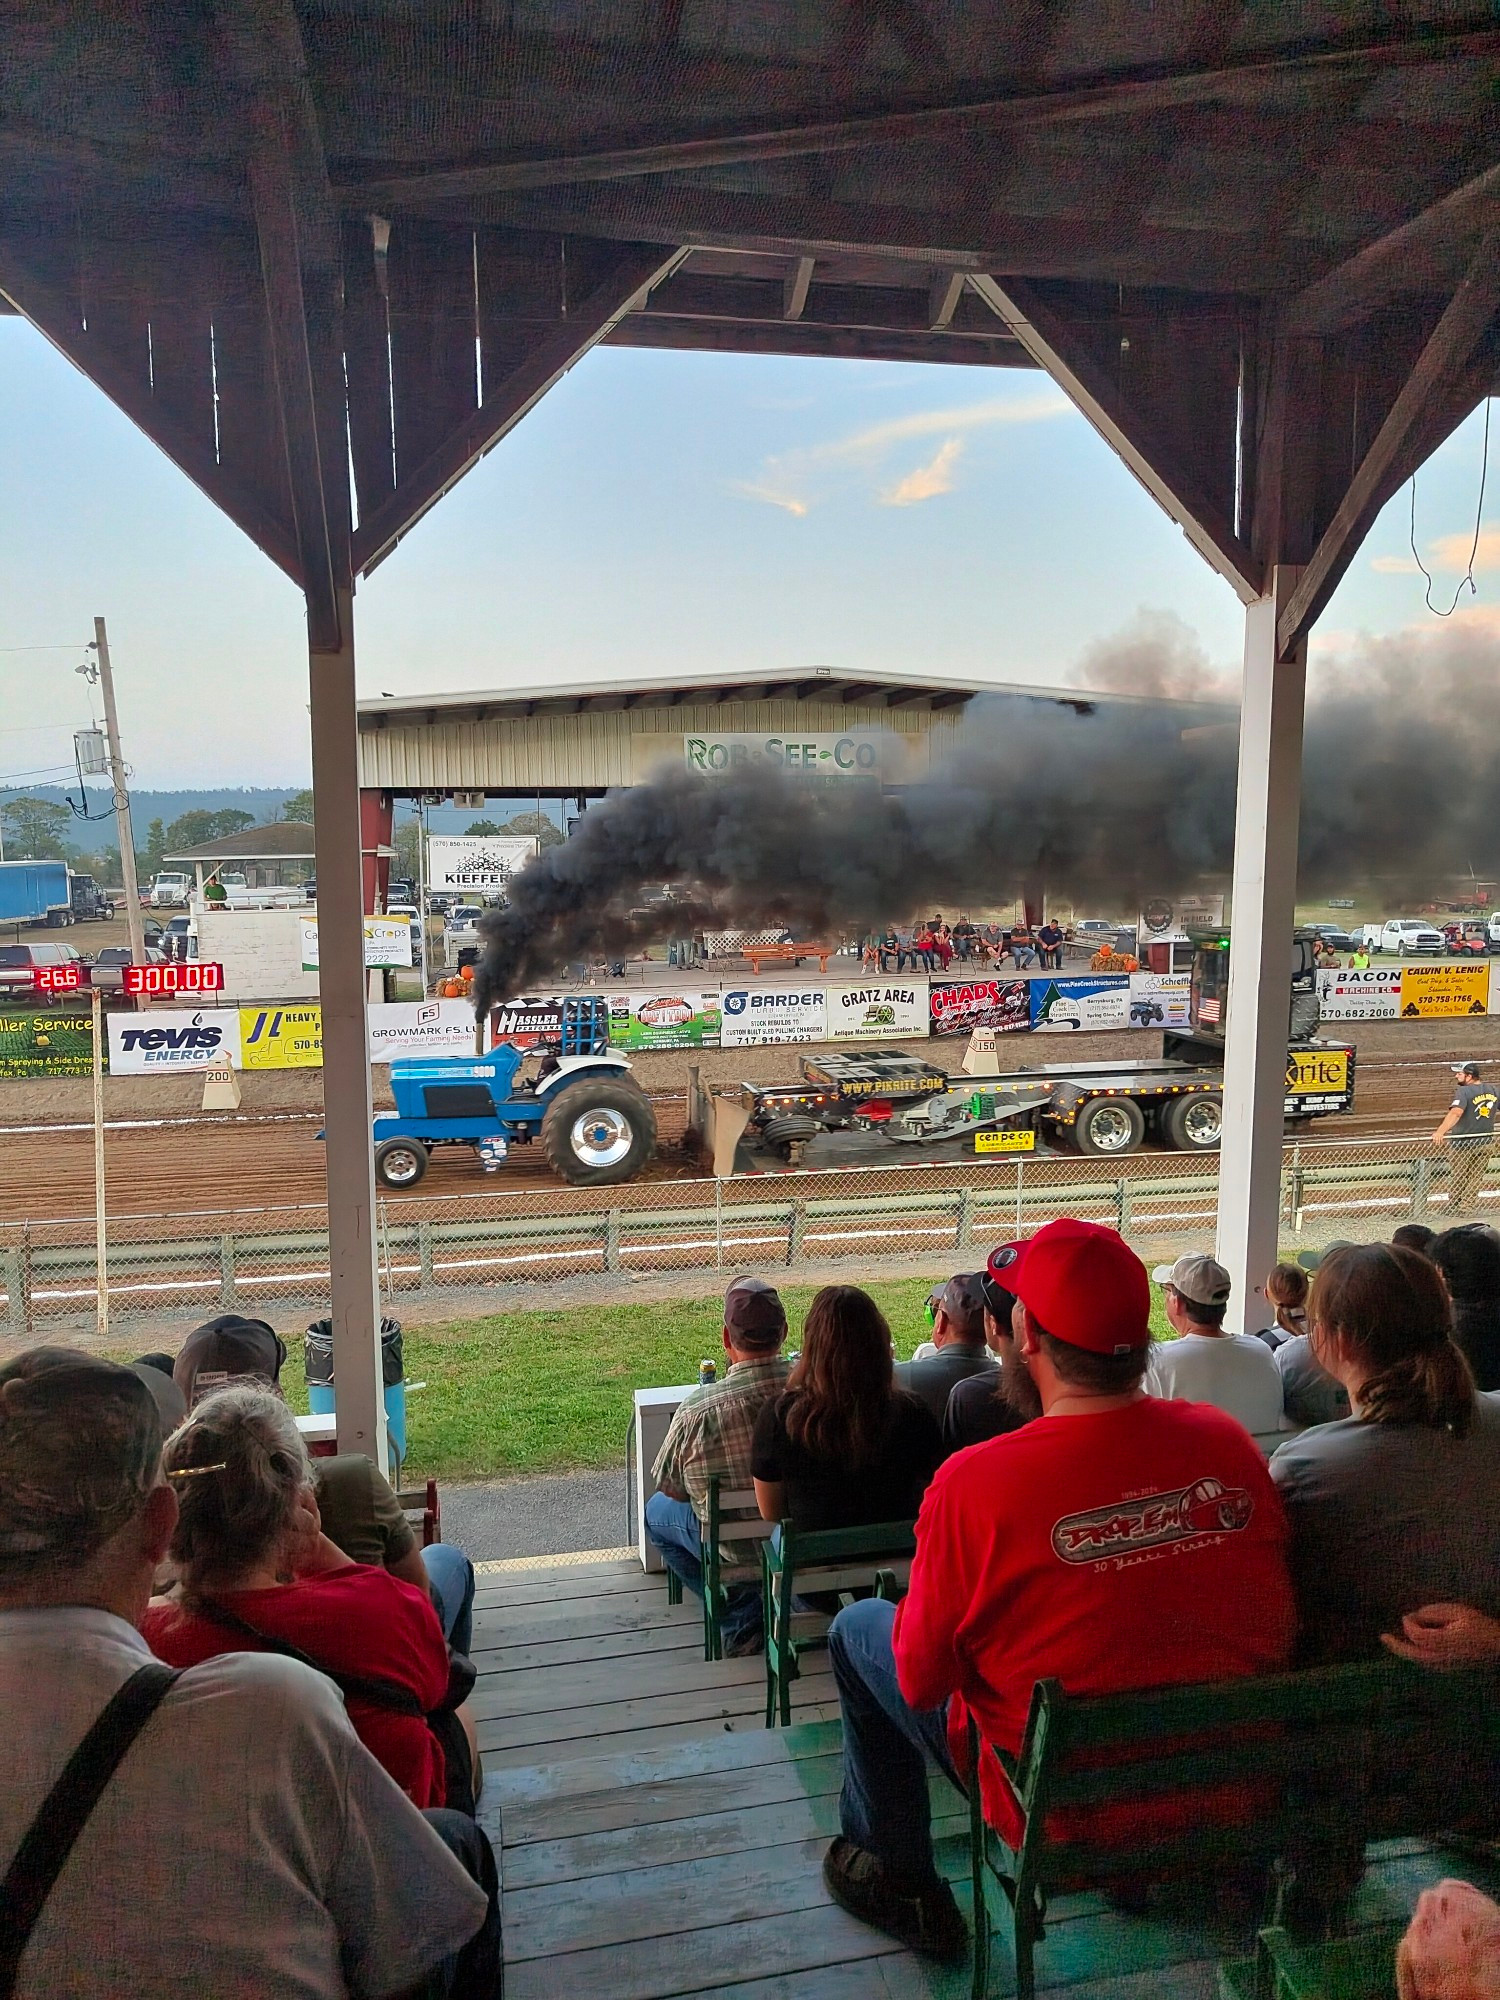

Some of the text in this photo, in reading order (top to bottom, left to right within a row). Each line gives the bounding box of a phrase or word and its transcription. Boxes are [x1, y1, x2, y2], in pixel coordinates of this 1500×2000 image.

[1408, 966, 1485, 976] CALVIN V. LENIG
[128, 965, 218, 992] 300.00
[1337, 972, 1402, 982] BACON
[1381, 986, 1395, 994] CO.
[750, 993, 824, 1007] BARDER
[841, 988, 915, 1008] GRATZ AREA
[931, 980, 1001, 1018] CHADS
[1418, 994, 1473, 1004] 570-758-1766
[285, 1012, 316, 1023] HEAVY
[422, 1008, 436, 1020] FS
[1320, 1008, 1396, 1018] 570-682-2060
[497, 1010, 559, 1034] HASSLER
[372, 1027, 441, 1038] GROWMARK
[833, 1029, 854, 1037] Antique
[855, 1028, 881, 1036] Machinery
[385, 1037, 409, 1045] Serving
[425, 1035, 451, 1043] Farming
[736, 1034, 812, 1045] 717-919-7423
[980, 1042, 995, 1050] 150
[144, 1049, 217, 1061] ENERGY
[8, 1056, 109, 1067] Spraying & Side Dresng
[207, 1071, 229, 1081] 200
[842, 1078, 944, 1094] WWW.PIKRITE.COM
[1001, 1133, 1016, 1142] pe
[1093, 1561, 1108, 1574] 30
